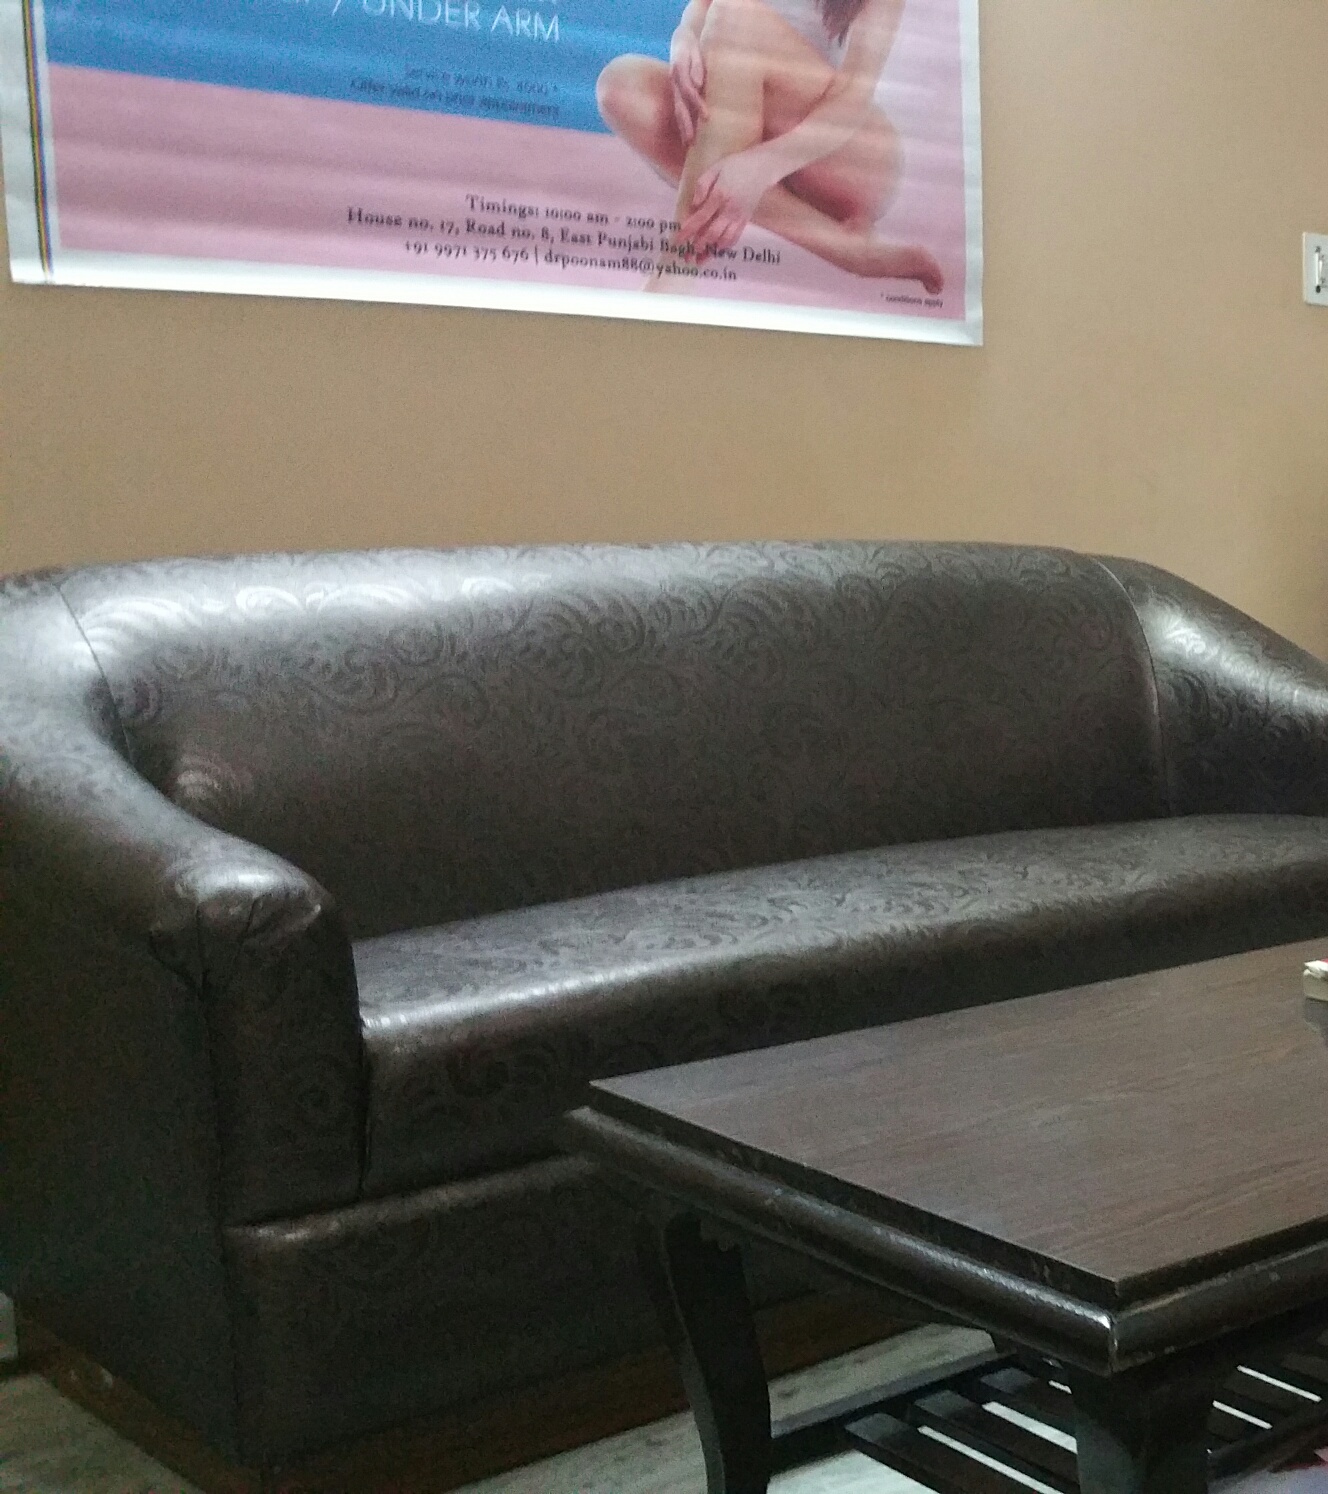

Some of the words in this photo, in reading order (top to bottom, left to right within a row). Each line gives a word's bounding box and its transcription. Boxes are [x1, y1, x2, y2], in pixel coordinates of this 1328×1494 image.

[362, 0, 481, 31] UNDER
[490, 7, 559, 42] ARM
[348, 205, 403, 227] House
[466, 216, 506, 236] Road
[560, 227, 592, 245] East
[598, 231, 654, 253] Punjabi
[704, 242, 737, 259] New
[743, 247, 781, 264] Delhi
[660, 220, 682, 233] pm
[434, 242, 467, 261] 9971
[472, 246, 497, 262] 375
[502, 245, 530, 265] 676
